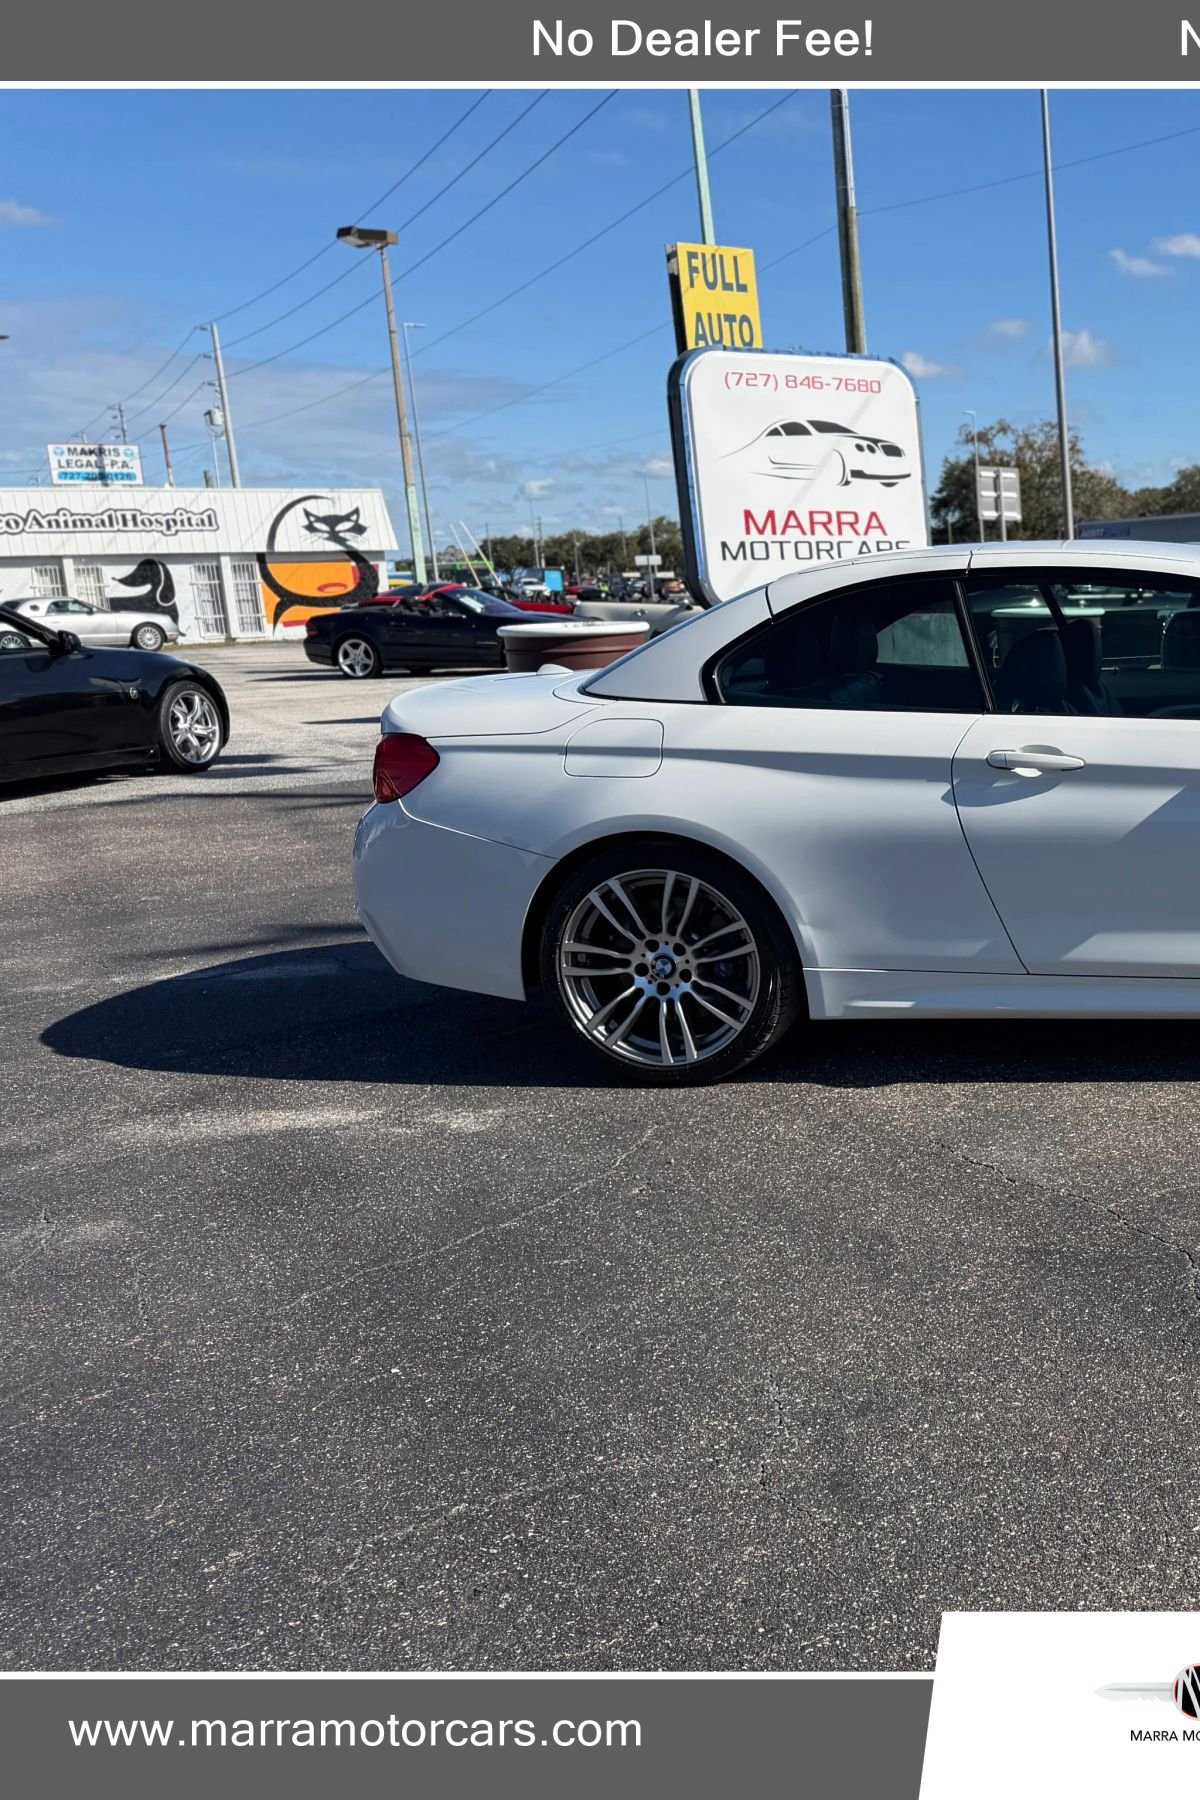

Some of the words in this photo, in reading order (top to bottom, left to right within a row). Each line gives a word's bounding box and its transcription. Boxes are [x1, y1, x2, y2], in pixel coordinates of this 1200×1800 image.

[686, 251, 748, 293] FULL
[694, 312, 754, 348] AUTO
[724, 371, 779, 392] (727)
[785, 375, 881, 394] 846-7680
[26, 509, 116, 530] Animal
[121, 510, 216, 533] Hospital
[743, 509, 888, 536] MARRA
